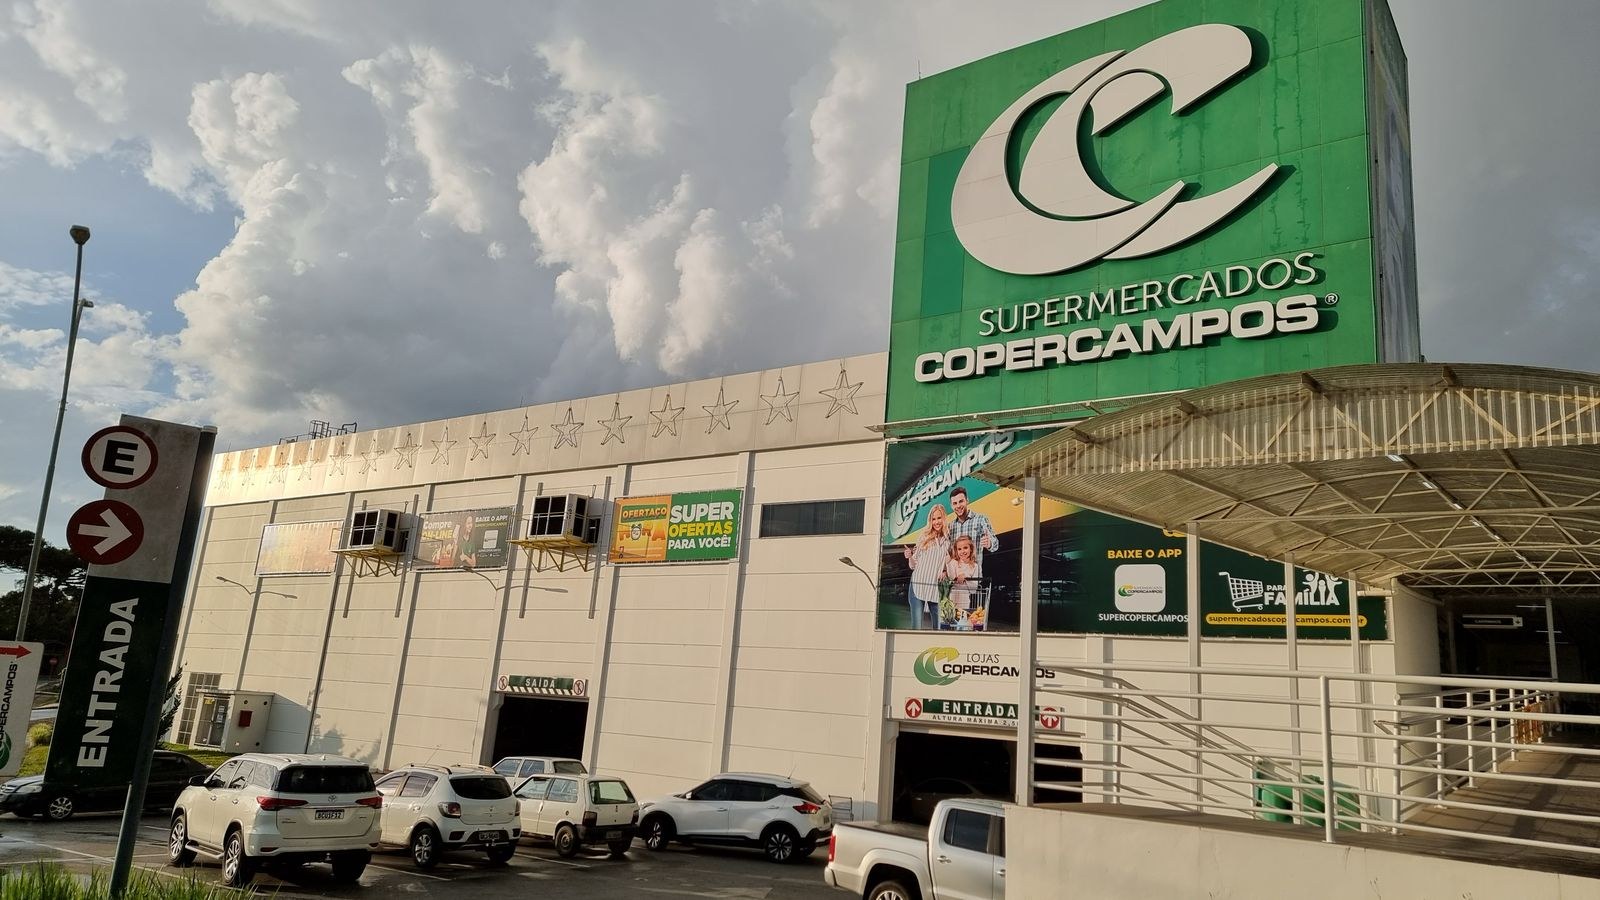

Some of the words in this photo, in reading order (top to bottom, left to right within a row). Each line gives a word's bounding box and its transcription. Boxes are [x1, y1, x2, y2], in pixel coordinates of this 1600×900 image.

[978, 252, 1318, 337] SUPERMERCADOS
[914, 293, 1319, 383] COPERCAMPOS
[102, 439, 139, 476] E
[902, 431, 1015, 517] COPERCAMPOS
[622, 507, 667, 519] OFERTAÇO
[669, 501, 734, 523] SUPER
[423, 520, 453, 530] Compre
[668, 521, 733, 538] OFERTAS
[668, 538, 696, 550] PARA
[699, 534, 731, 548] VOCÊ!
[1107, 549, 1143, 559] BAIXE
[1145, 549, 1155, 558] O
[1157, 548, 1182, 558] APP
[1264, 588, 1340, 606] FAMÍLIA
[1098, 613, 1189, 623] SUPERCOPERCAMPOS
[967, 653, 1000, 664] LOJAS
[942, 663, 1056, 679] COPERCAMOS
[77, 597, 139, 768] ENTRADA
[942, 701, 1016, 717] ENTRADA
[932, 714, 963, 722] ALTURA
